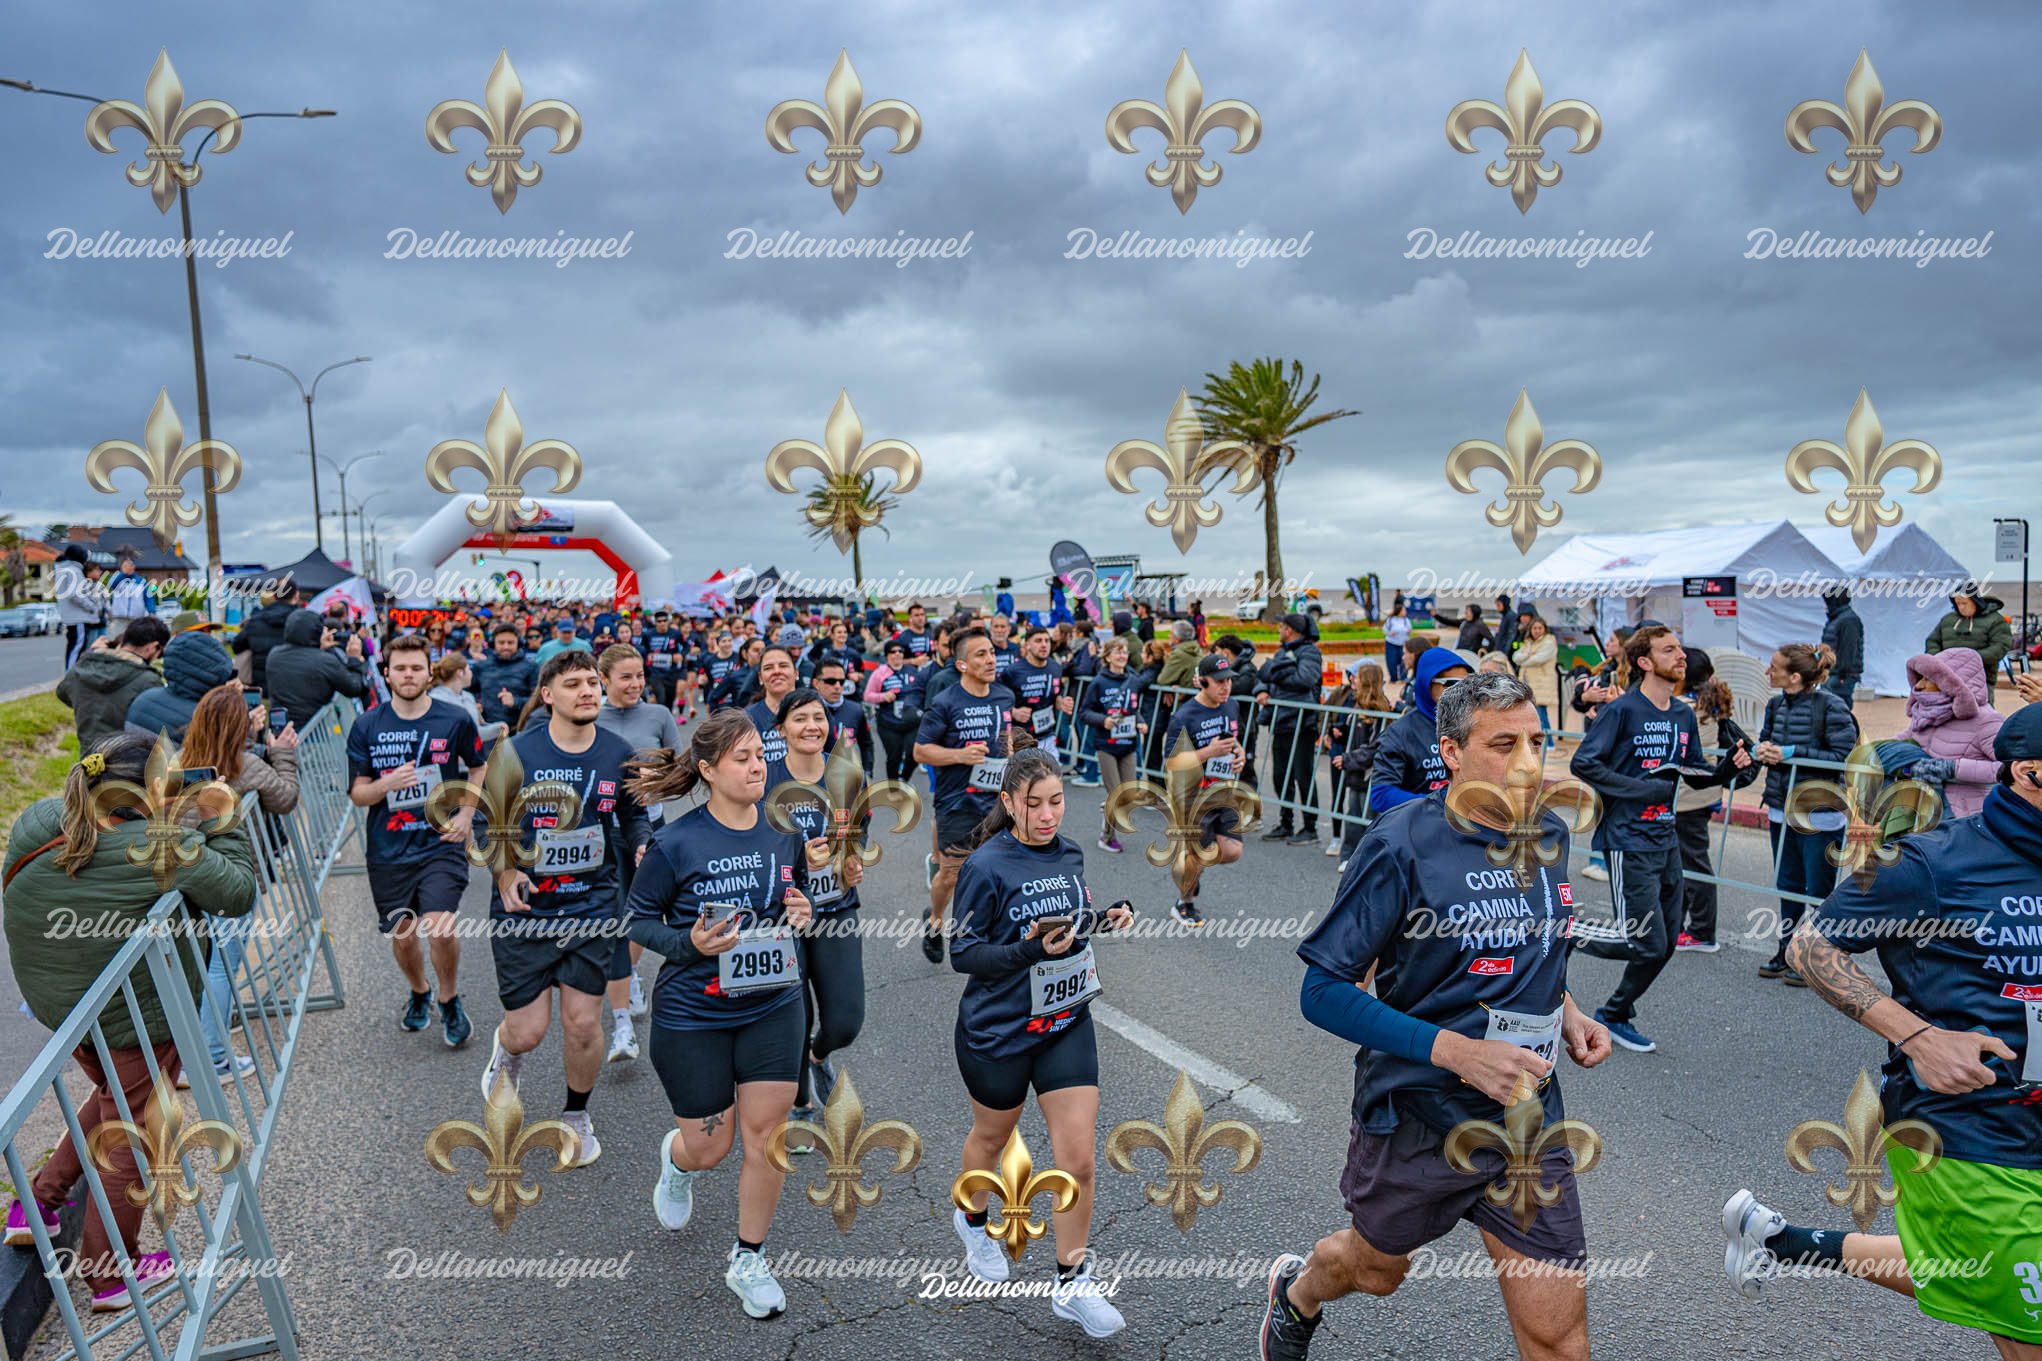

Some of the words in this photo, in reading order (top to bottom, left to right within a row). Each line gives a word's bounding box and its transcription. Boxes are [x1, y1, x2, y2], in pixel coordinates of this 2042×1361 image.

[964, 704, 994, 716] CORRÉ
[956, 716, 993, 729] CAMINÁ
[1644, 721, 1672, 732] CORRÉ
[378, 729, 418, 742] CORRÉ
[959, 729, 990, 740] AYUDÁ
[1634, 733, 1670, 745] CAMINÁ
[1635, 746, 1667, 757] AYUDÁ
[534, 767, 583, 782] CORRÉ
[1425, 770, 1446, 779] AYU
[521, 783, 576, 799] CAMINÁ
[526, 801, 568, 814] AYUDÁ
[545, 844, 591, 866] 2994
[707, 852, 764, 875] CORRÉ
[693, 872, 760, 896] CAMINÁ
[811, 873, 840, 896] 202
[1022, 874, 1071, 896] CORRÉ
[1465, 865, 1534, 891] CORRÉ
[698, 893, 753, 914] ADÁ
[1009, 892, 1072, 921] CAMINÁ
[1449, 893, 1534, 925] CAMINÁ
[1460, 923, 1527, 952] AYUDÁ
[731, 950, 784, 979] 2993
[1044, 968, 1087, 1007] 2992
[2013, 1261, 2042, 1304] 3
